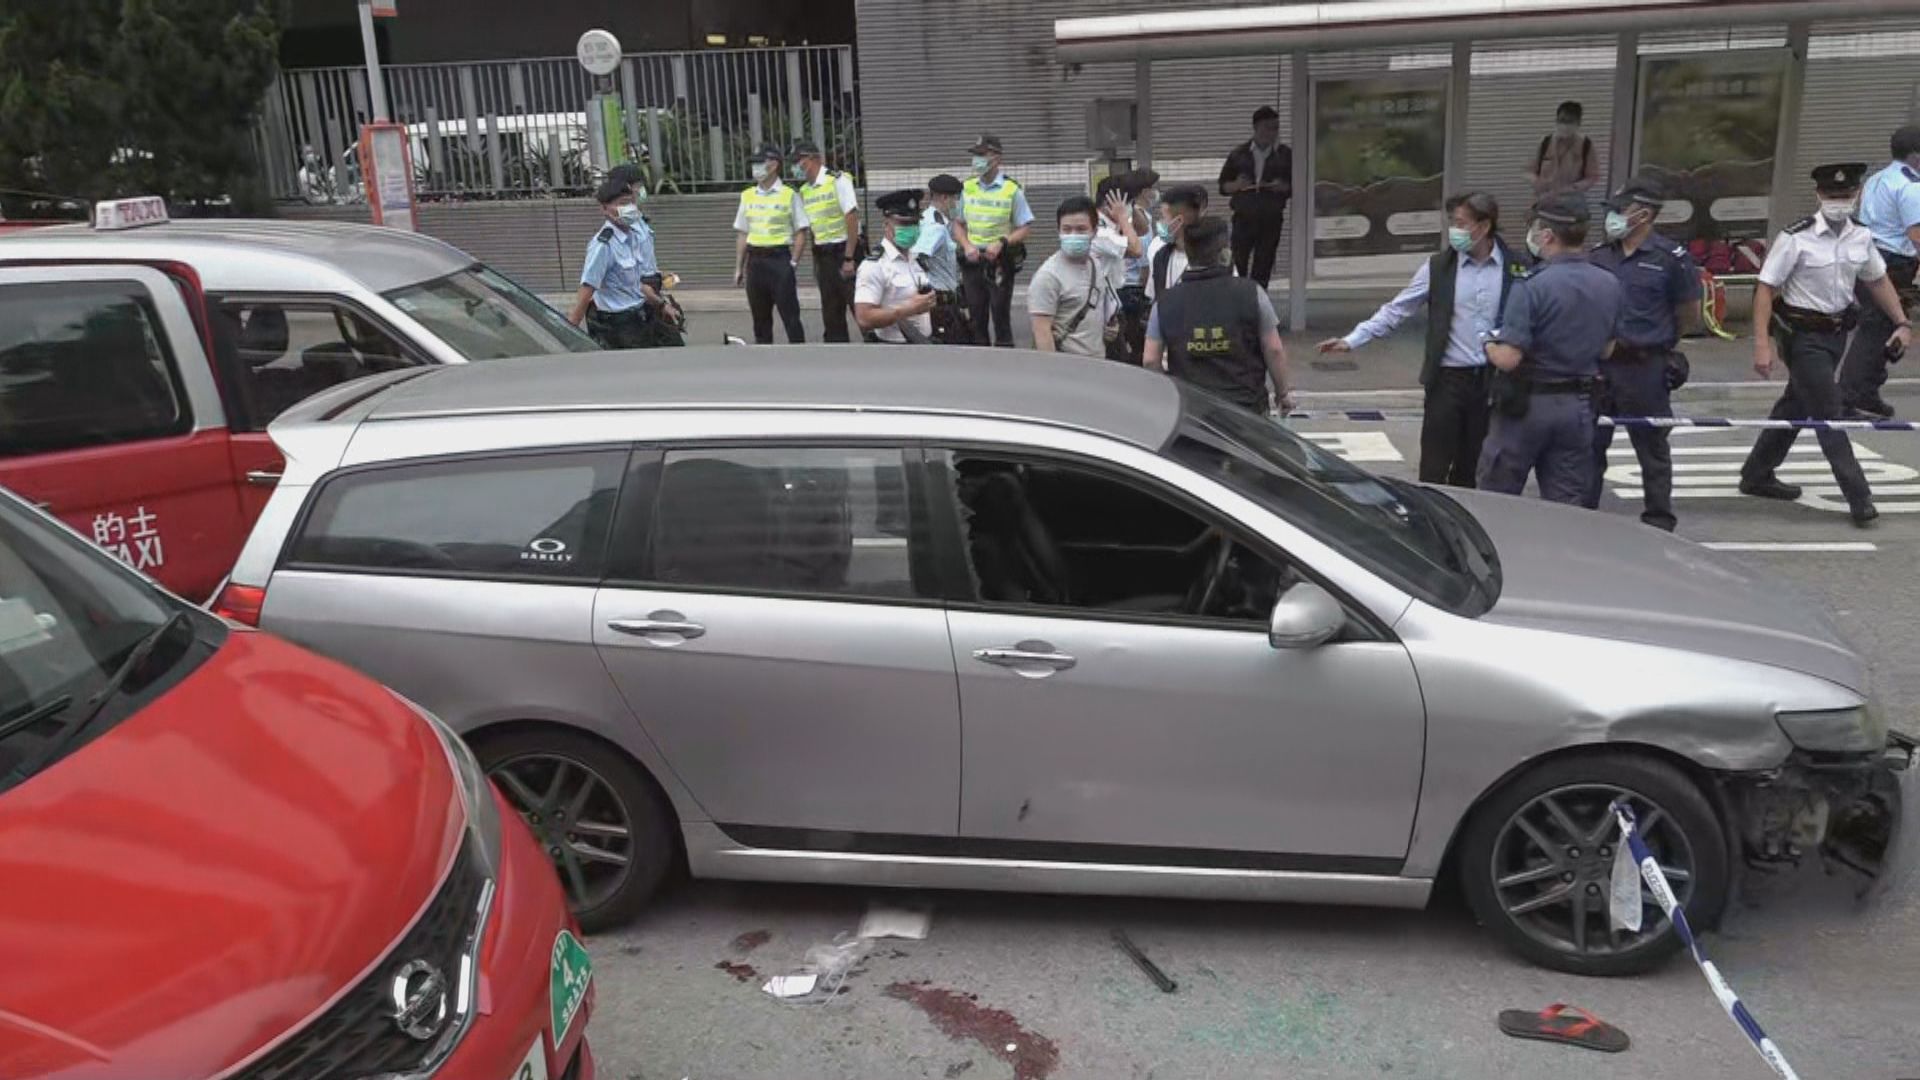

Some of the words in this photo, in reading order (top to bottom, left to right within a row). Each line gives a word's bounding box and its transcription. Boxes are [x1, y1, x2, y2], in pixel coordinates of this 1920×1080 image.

[118, 199, 163, 223] TAXI
[1187, 340, 1231, 352] POLICE
[92, 505, 158, 544] 的士
[562, 957, 574, 988] 4
[561, 965, 588, 1023] SEATS
